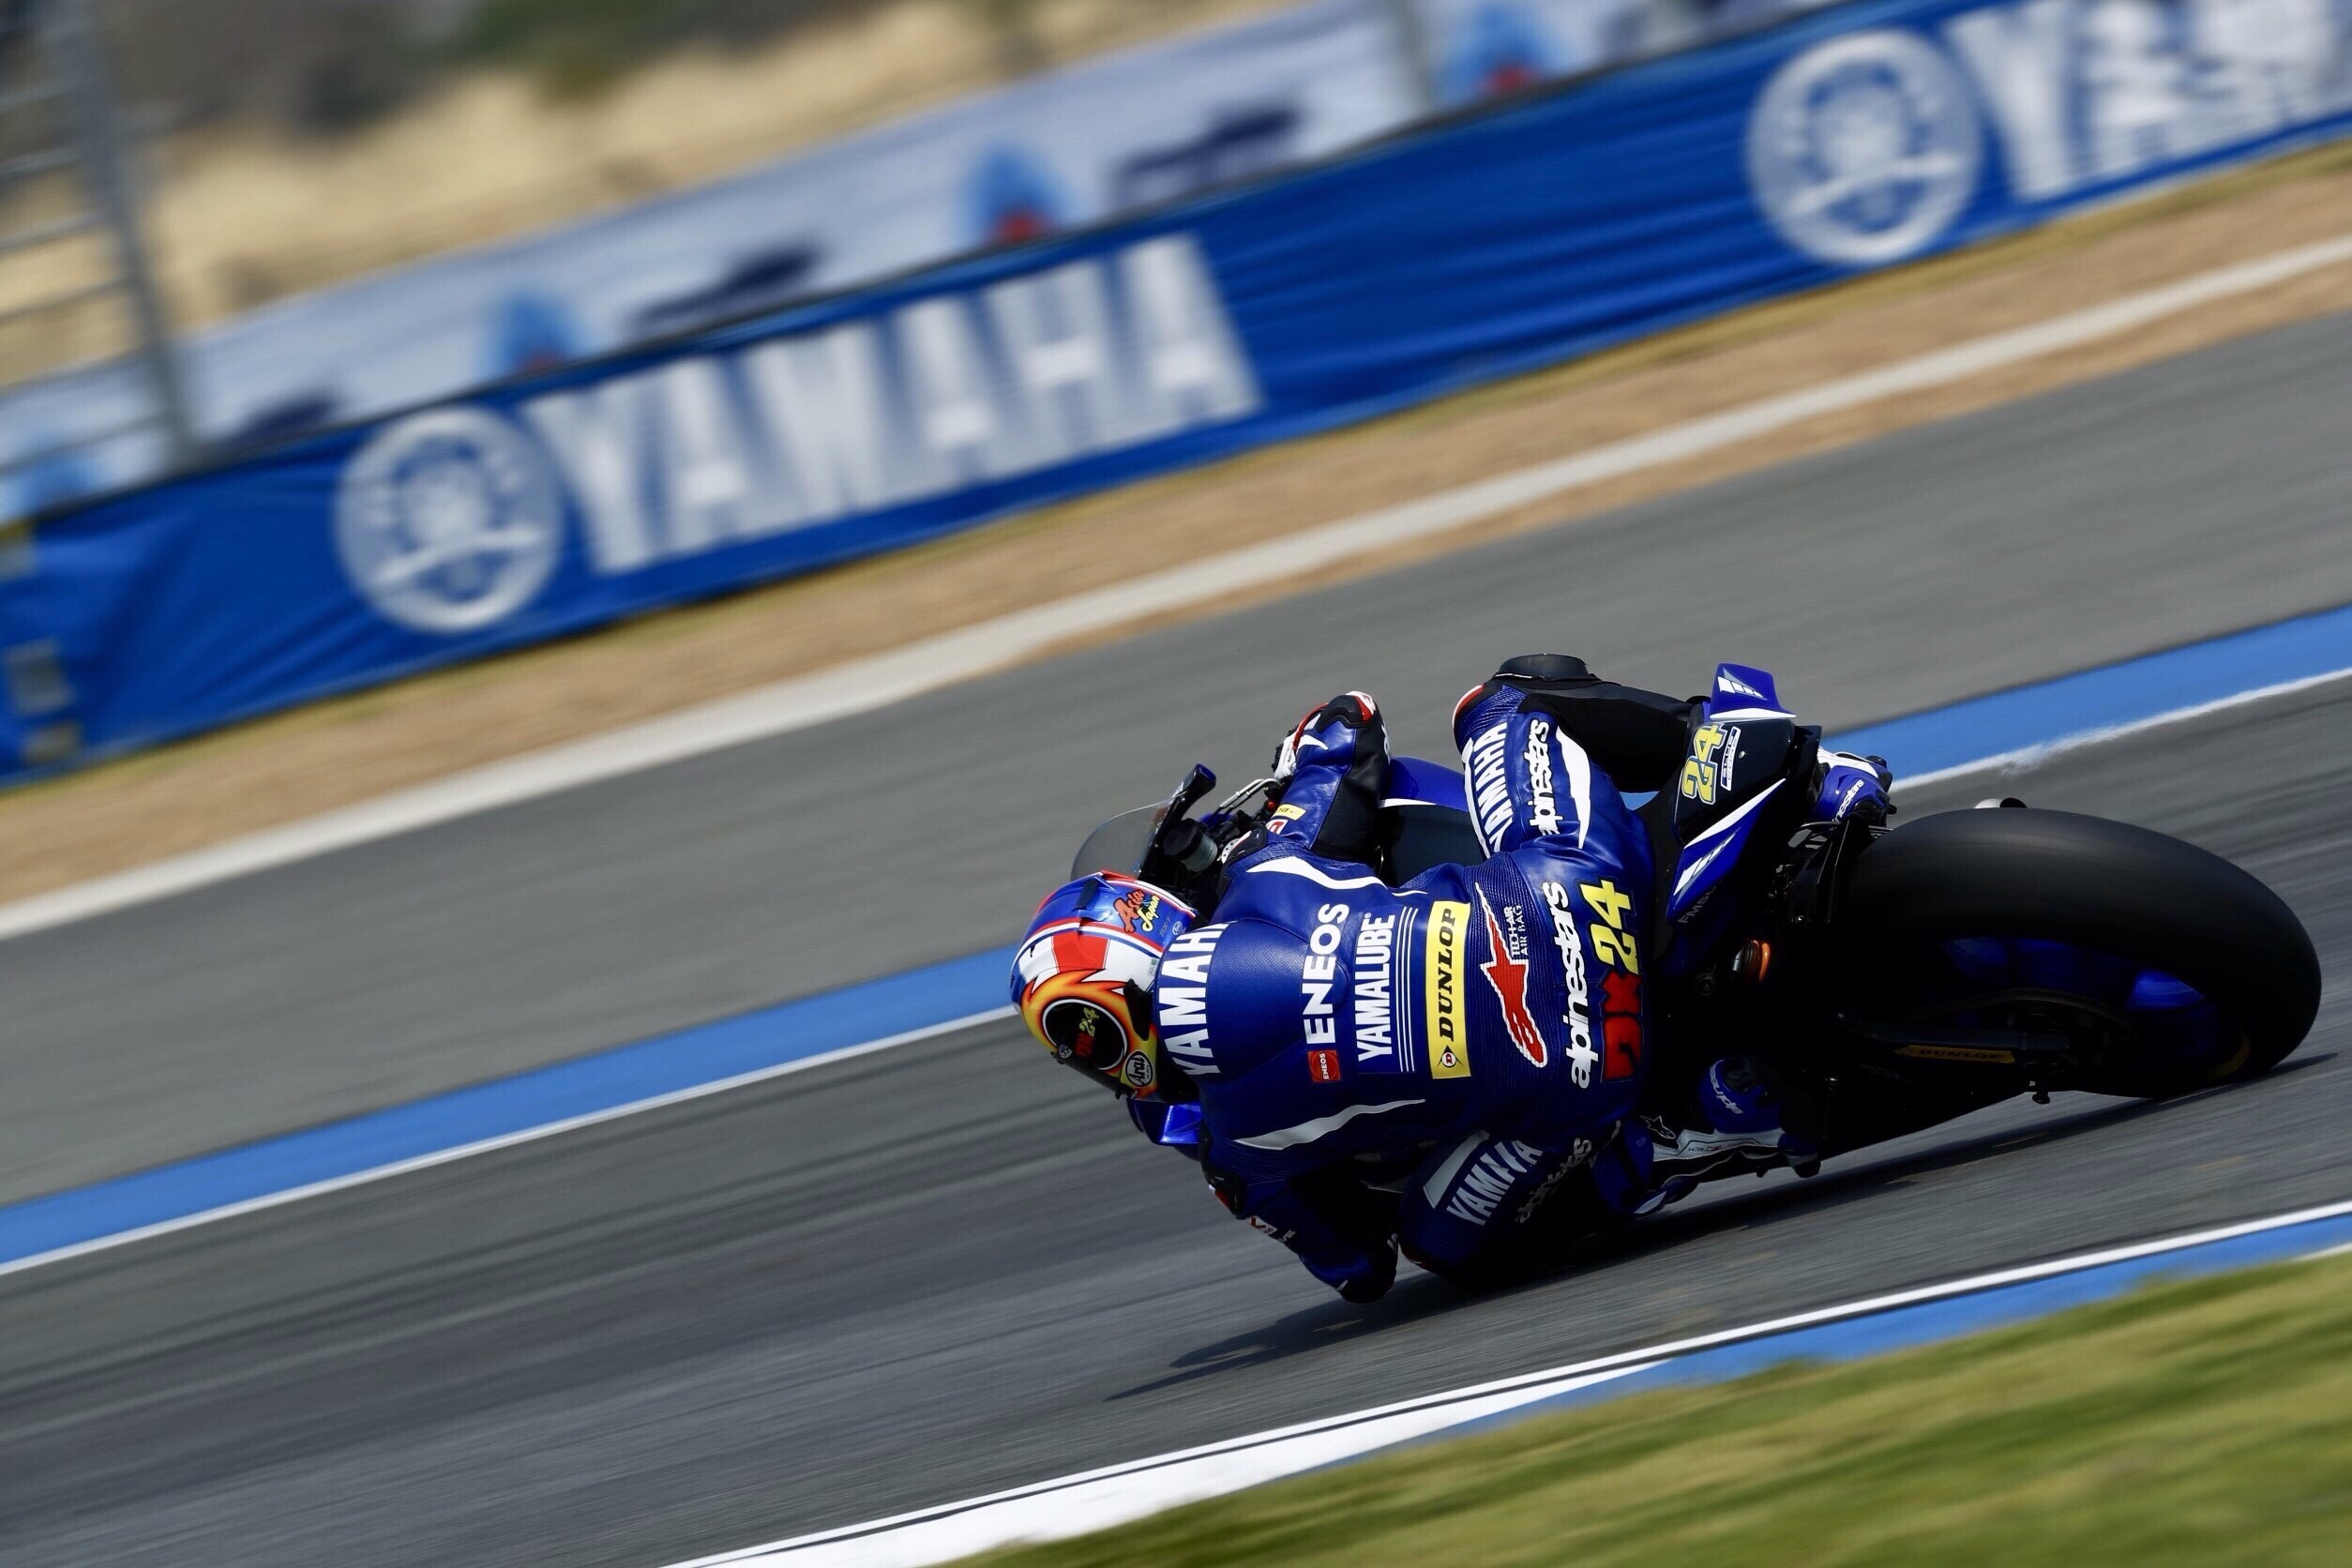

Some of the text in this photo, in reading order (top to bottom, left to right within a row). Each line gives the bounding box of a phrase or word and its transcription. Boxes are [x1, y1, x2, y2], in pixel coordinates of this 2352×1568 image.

[521, 232, 1264, 576] YAMAHA
[1471, 722, 1515, 854] YAMAHA
[1681, 724, 1725, 804] 24
[1832, 778, 1864, 822] nestars
[1113, 888, 1145, 933] Asia
[1140, 892, 1160, 932] Japan
[1513, 905, 1529, 956] AIR BAG
[1303, 903, 1349, 1045] ENEOS
[1435, 908, 1456, 1043] DUNLOP
[1543, 882, 1598, 1089] alpinestars
[1128, 1055, 1146, 1085] Arai
[1317, 1051, 1330, 1080] ENEOS
